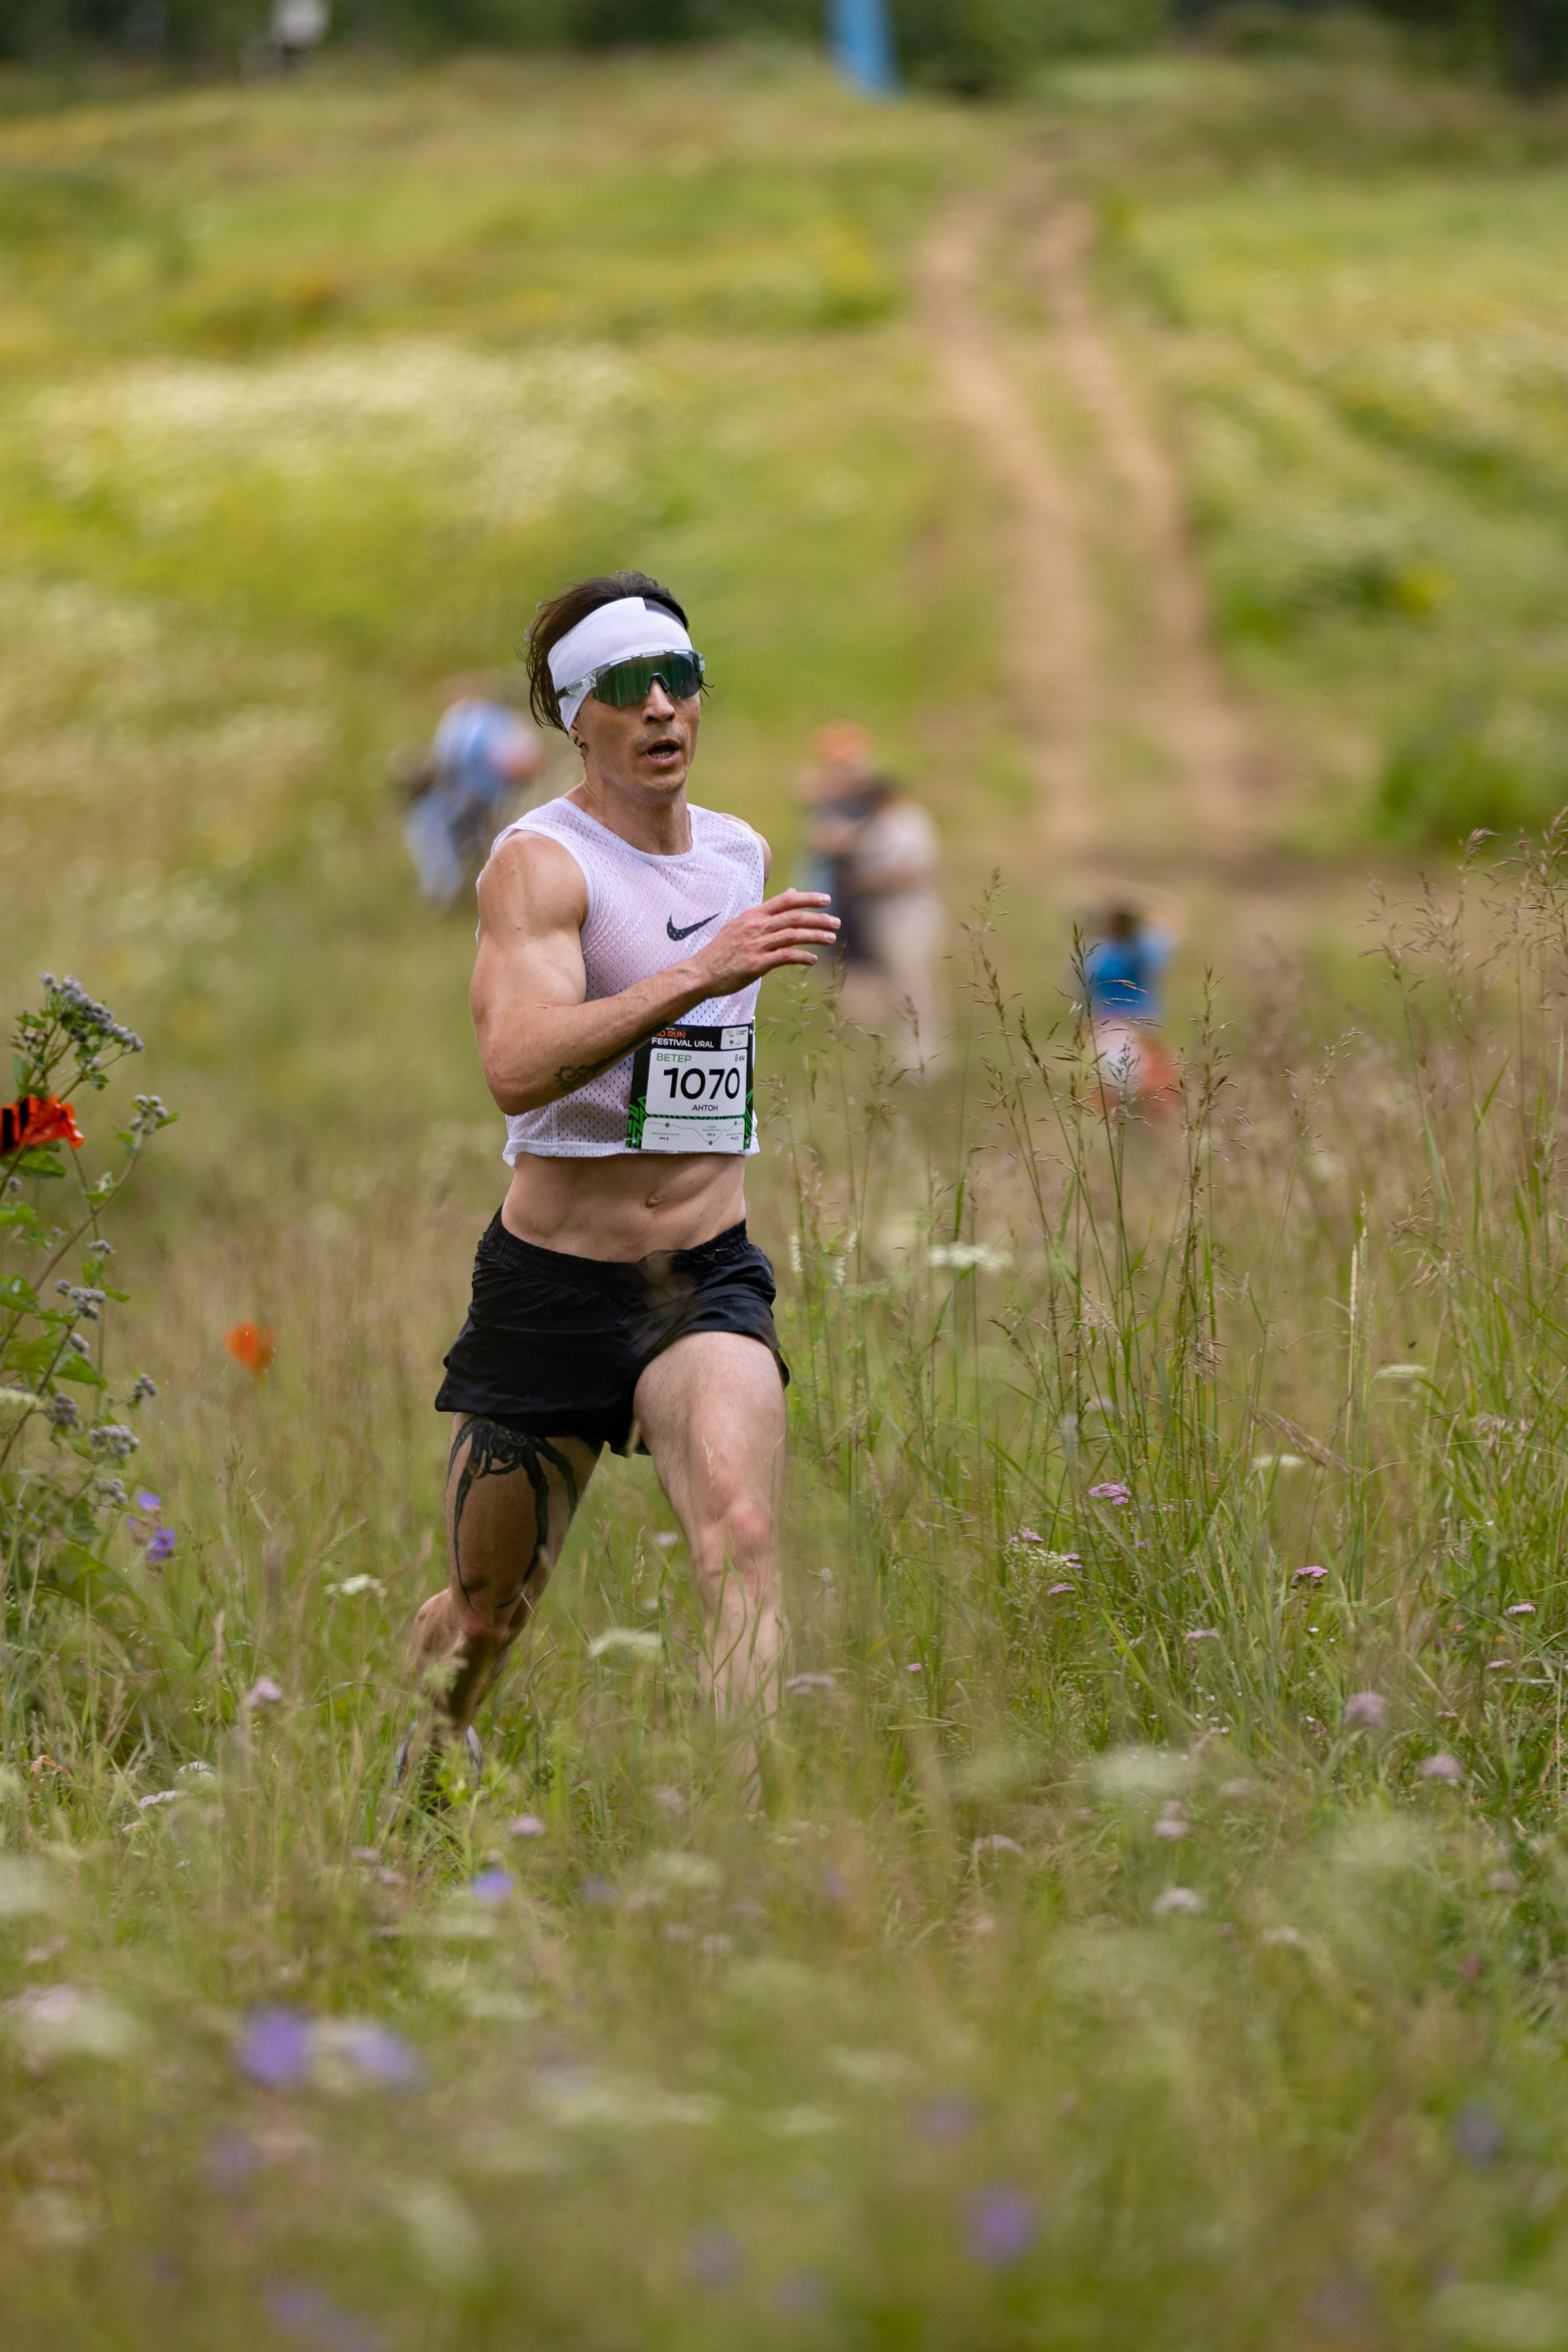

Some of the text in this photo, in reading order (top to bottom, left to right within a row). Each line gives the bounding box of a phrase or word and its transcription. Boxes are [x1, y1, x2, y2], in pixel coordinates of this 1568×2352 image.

[667, 1030, 686, 1039] RUN
[651, 1036, 693, 1047] FESTIVAL
[656, 1052, 692, 1063] ВЕТЕР
[734, 1054, 739, 1062] 8
[663, 1067, 740, 1099] 1070
